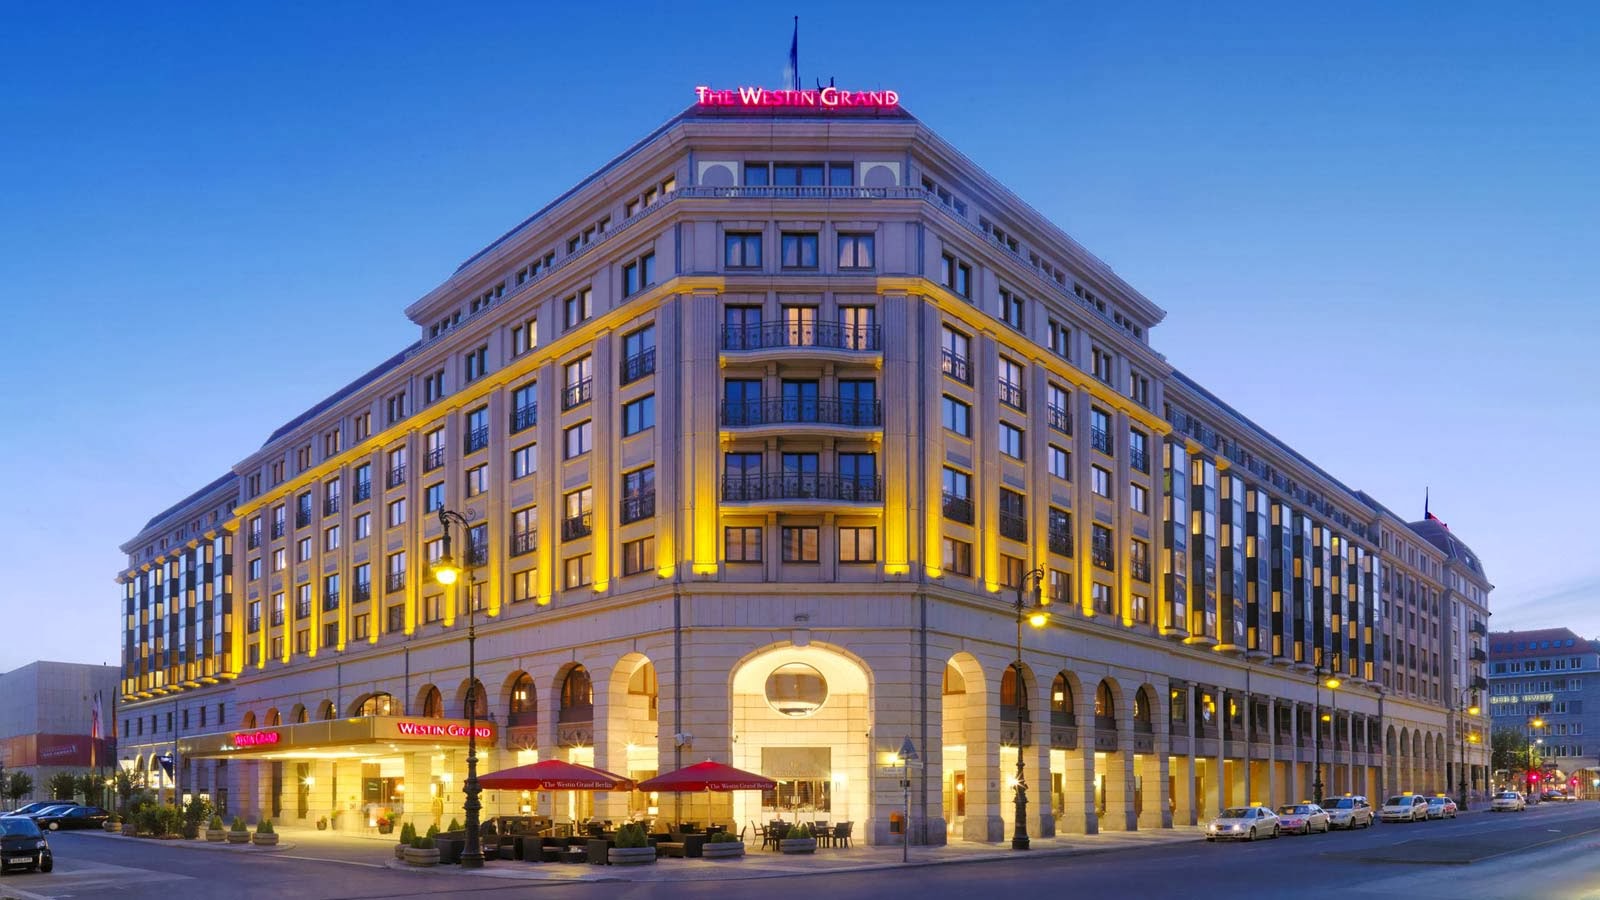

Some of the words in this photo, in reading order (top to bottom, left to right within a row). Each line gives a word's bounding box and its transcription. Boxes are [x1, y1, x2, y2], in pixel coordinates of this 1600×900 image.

[696, 86, 733, 105] THE
[738, 87, 815, 105] WESTIN
[820, 87, 899, 105] GRAND
[398, 723, 445, 735] WESTIN
